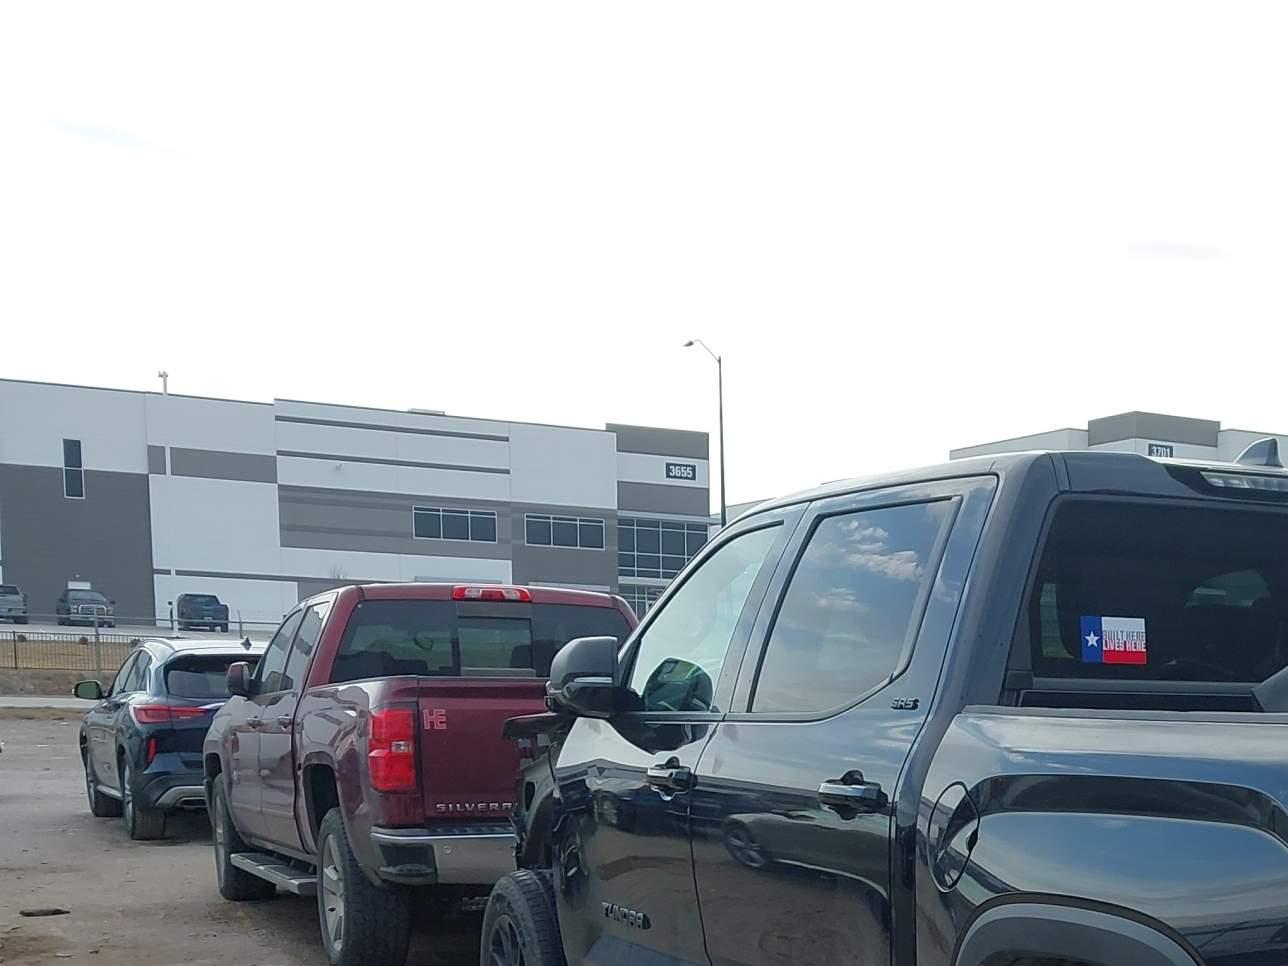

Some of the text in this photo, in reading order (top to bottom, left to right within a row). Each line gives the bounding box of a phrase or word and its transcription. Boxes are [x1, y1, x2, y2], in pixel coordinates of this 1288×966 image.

[1151, 445, 1170, 457] 3701
[669, 465, 693, 478] 3655
[1103, 630, 1146, 642] BUILT HERE
[1103, 640, 1147, 652] LIVES HERE
[436, 802, 514, 813] SILVERA
[601, 901, 646, 929] TUNDRA
